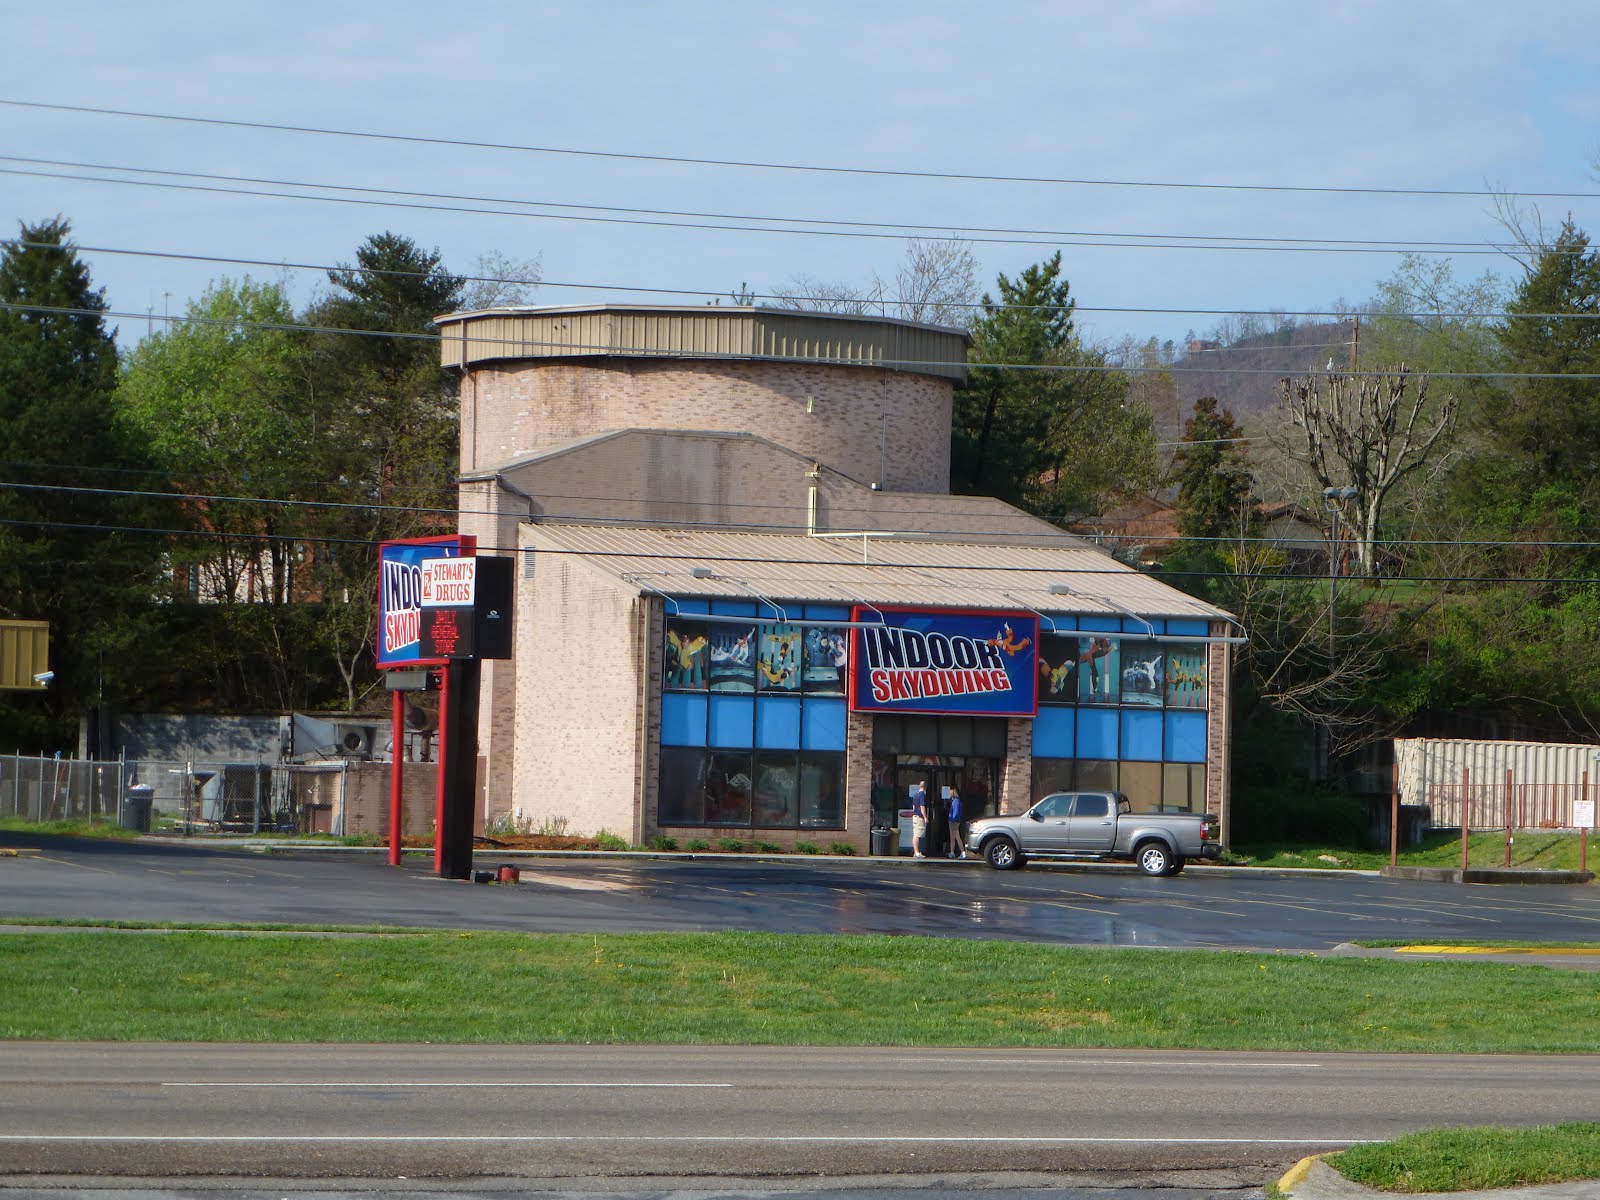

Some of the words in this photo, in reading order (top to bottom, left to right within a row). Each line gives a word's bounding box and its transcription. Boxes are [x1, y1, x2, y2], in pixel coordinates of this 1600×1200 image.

[383, 560, 421, 614] INDO
[434, 563, 474, 581] STEWART'S
[436, 583, 471, 602] DRUGS
[385, 611, 421, 653] SKYDI
[864, 626, 1005, 671] INDOOR
[871, 668, 1012, 703] SKYDIVING
